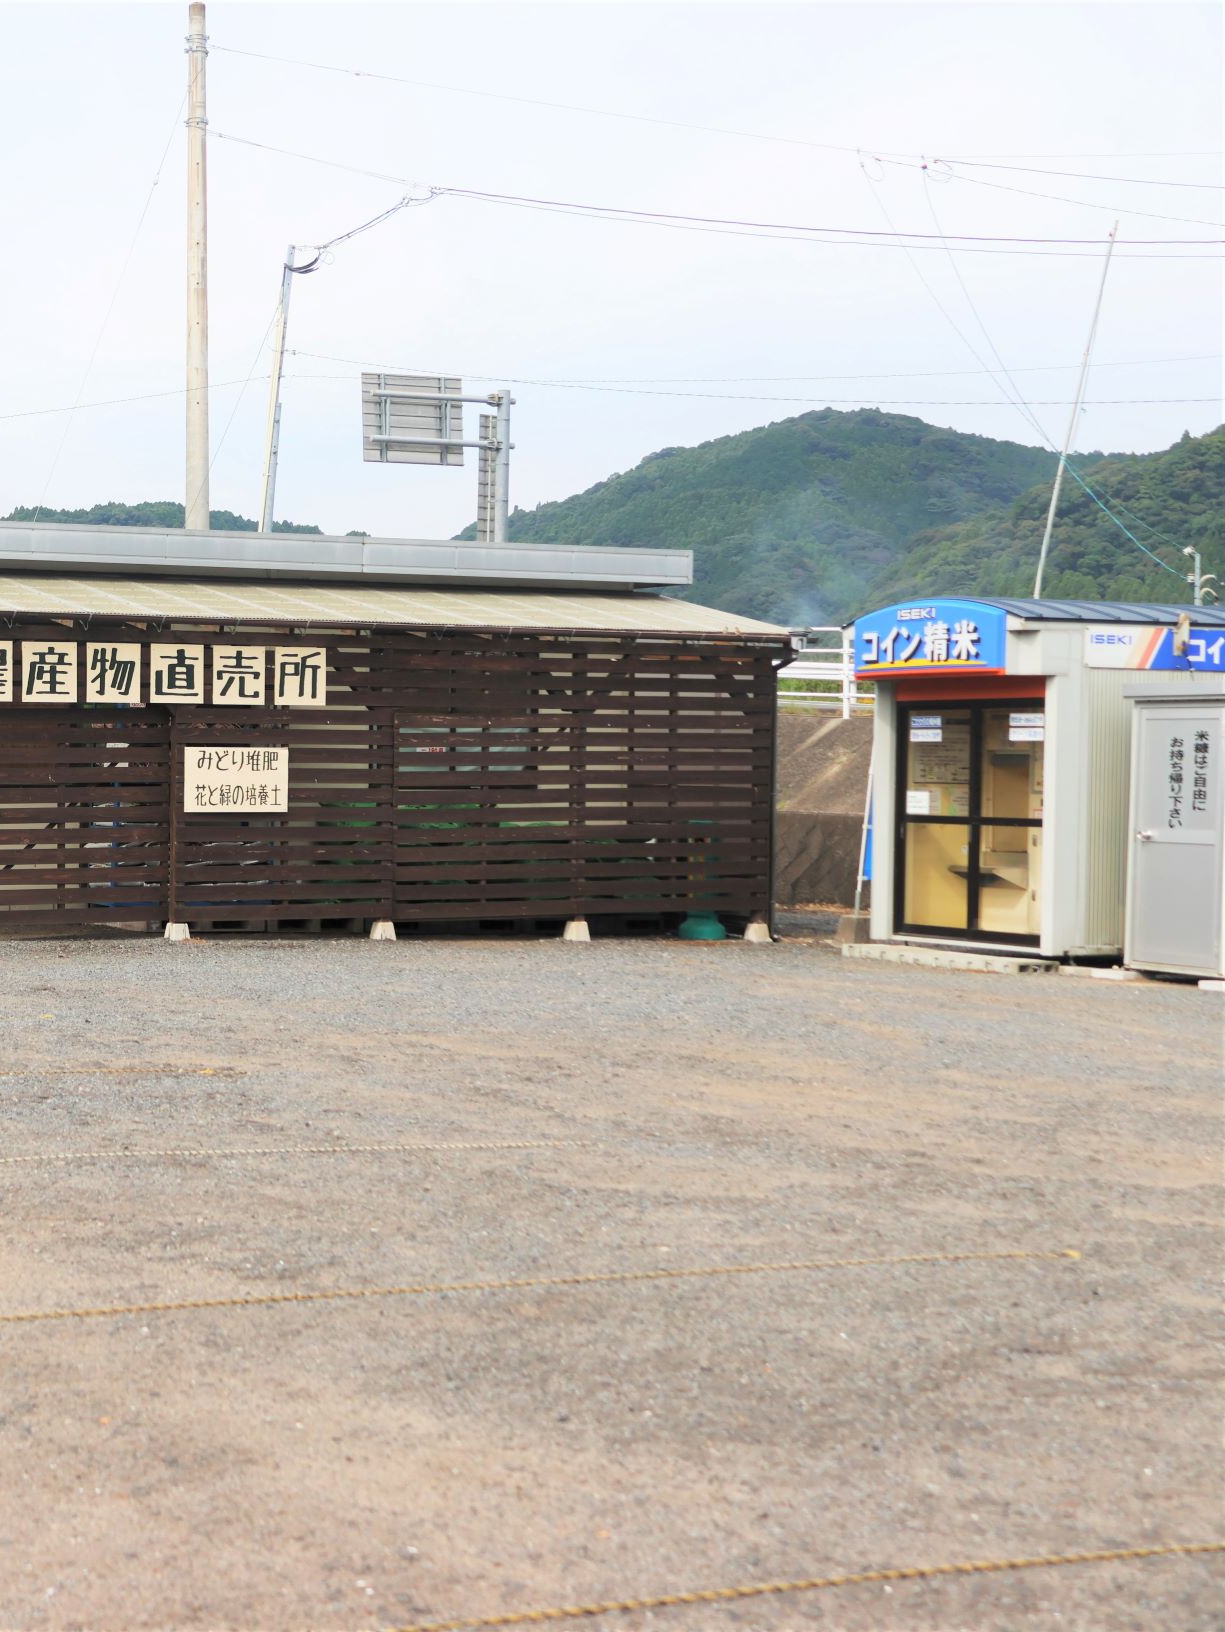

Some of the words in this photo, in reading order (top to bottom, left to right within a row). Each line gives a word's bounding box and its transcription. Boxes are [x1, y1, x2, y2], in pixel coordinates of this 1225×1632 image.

[897, 607, 936, 620] ISEKI
[862, 620, 980, 663] コイン精米
[1090, 634, 1132, 645] ISEKI
[197, 750, 279, 772] みどり堆肥
[194, 784, 282, 806] 花と緑の培養土
